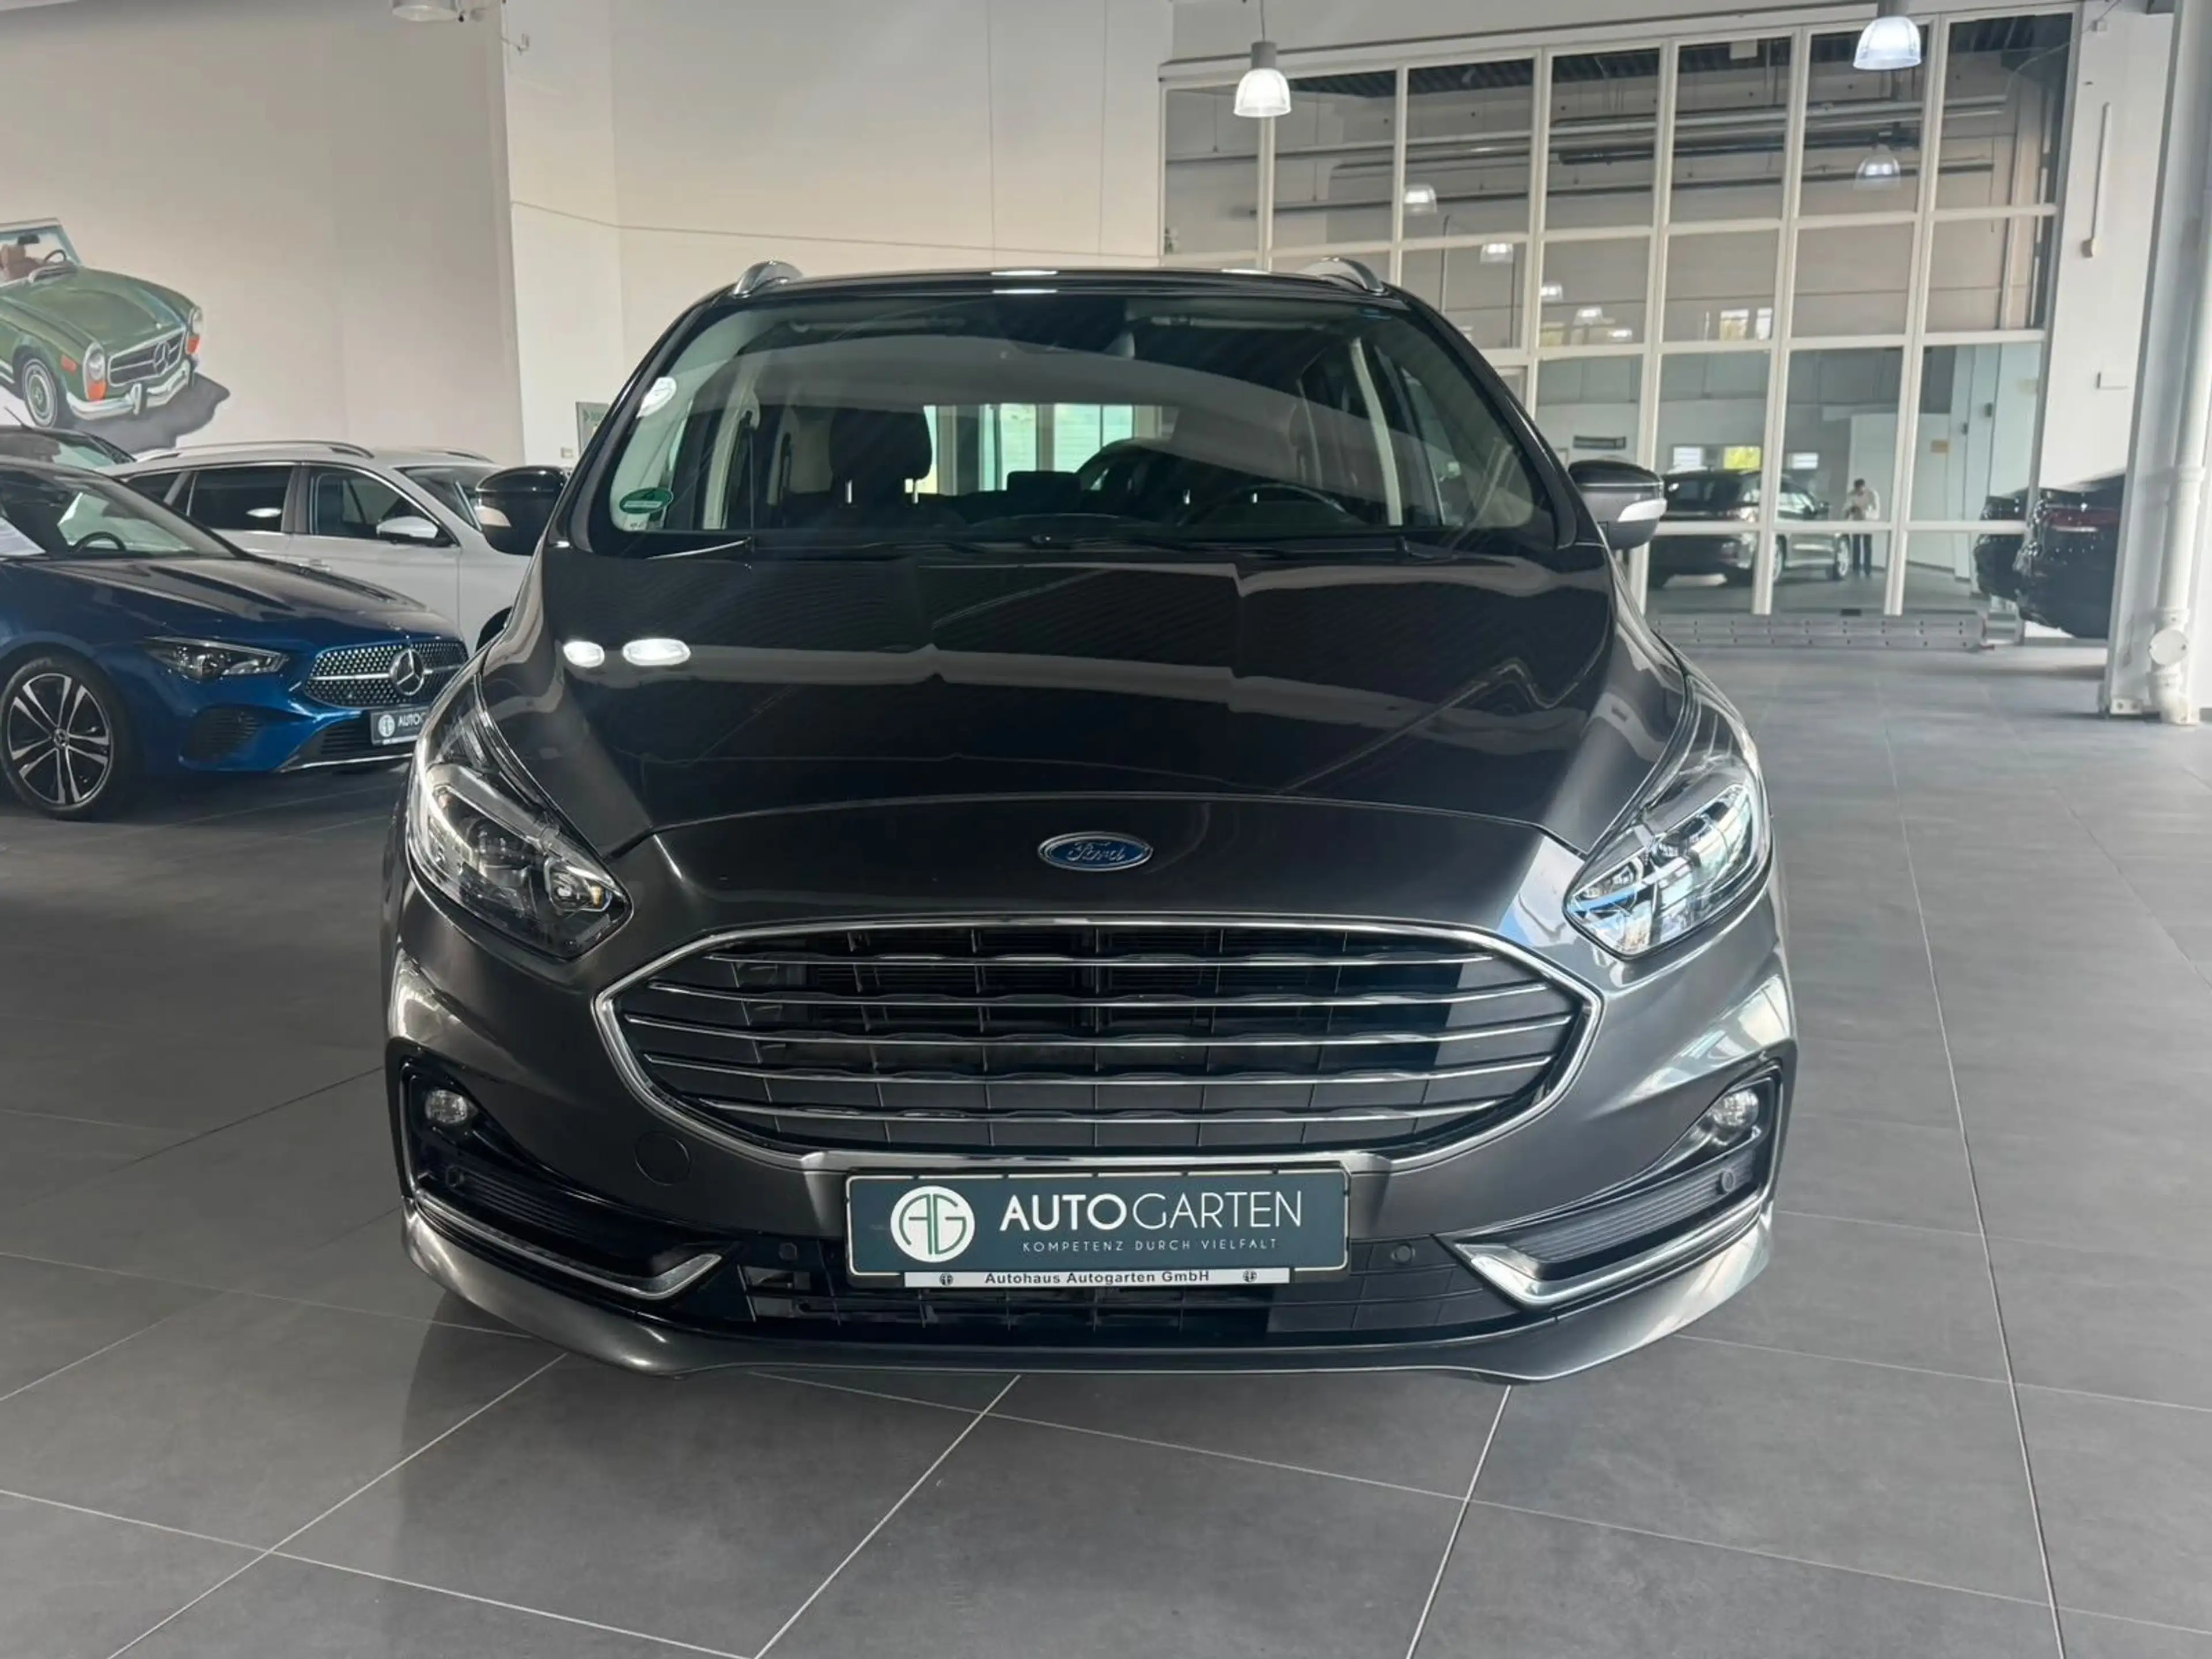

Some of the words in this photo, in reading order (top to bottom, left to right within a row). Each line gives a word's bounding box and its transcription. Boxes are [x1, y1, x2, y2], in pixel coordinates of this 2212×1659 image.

[1066, 842, 1126, 861] Ford
[1022, 1241, 1123, 1252] KOMPETENZ
[1135, 1240, 1190, 1251] DURCH
[1201, 1238, 1276, 1250] VIELFALT
[985, 1273, 1060, 1285] Autohaus
[1066, 1272, 1155, 1285] Autogarten
[1161, 1271, 1209, 1282] GmbH
